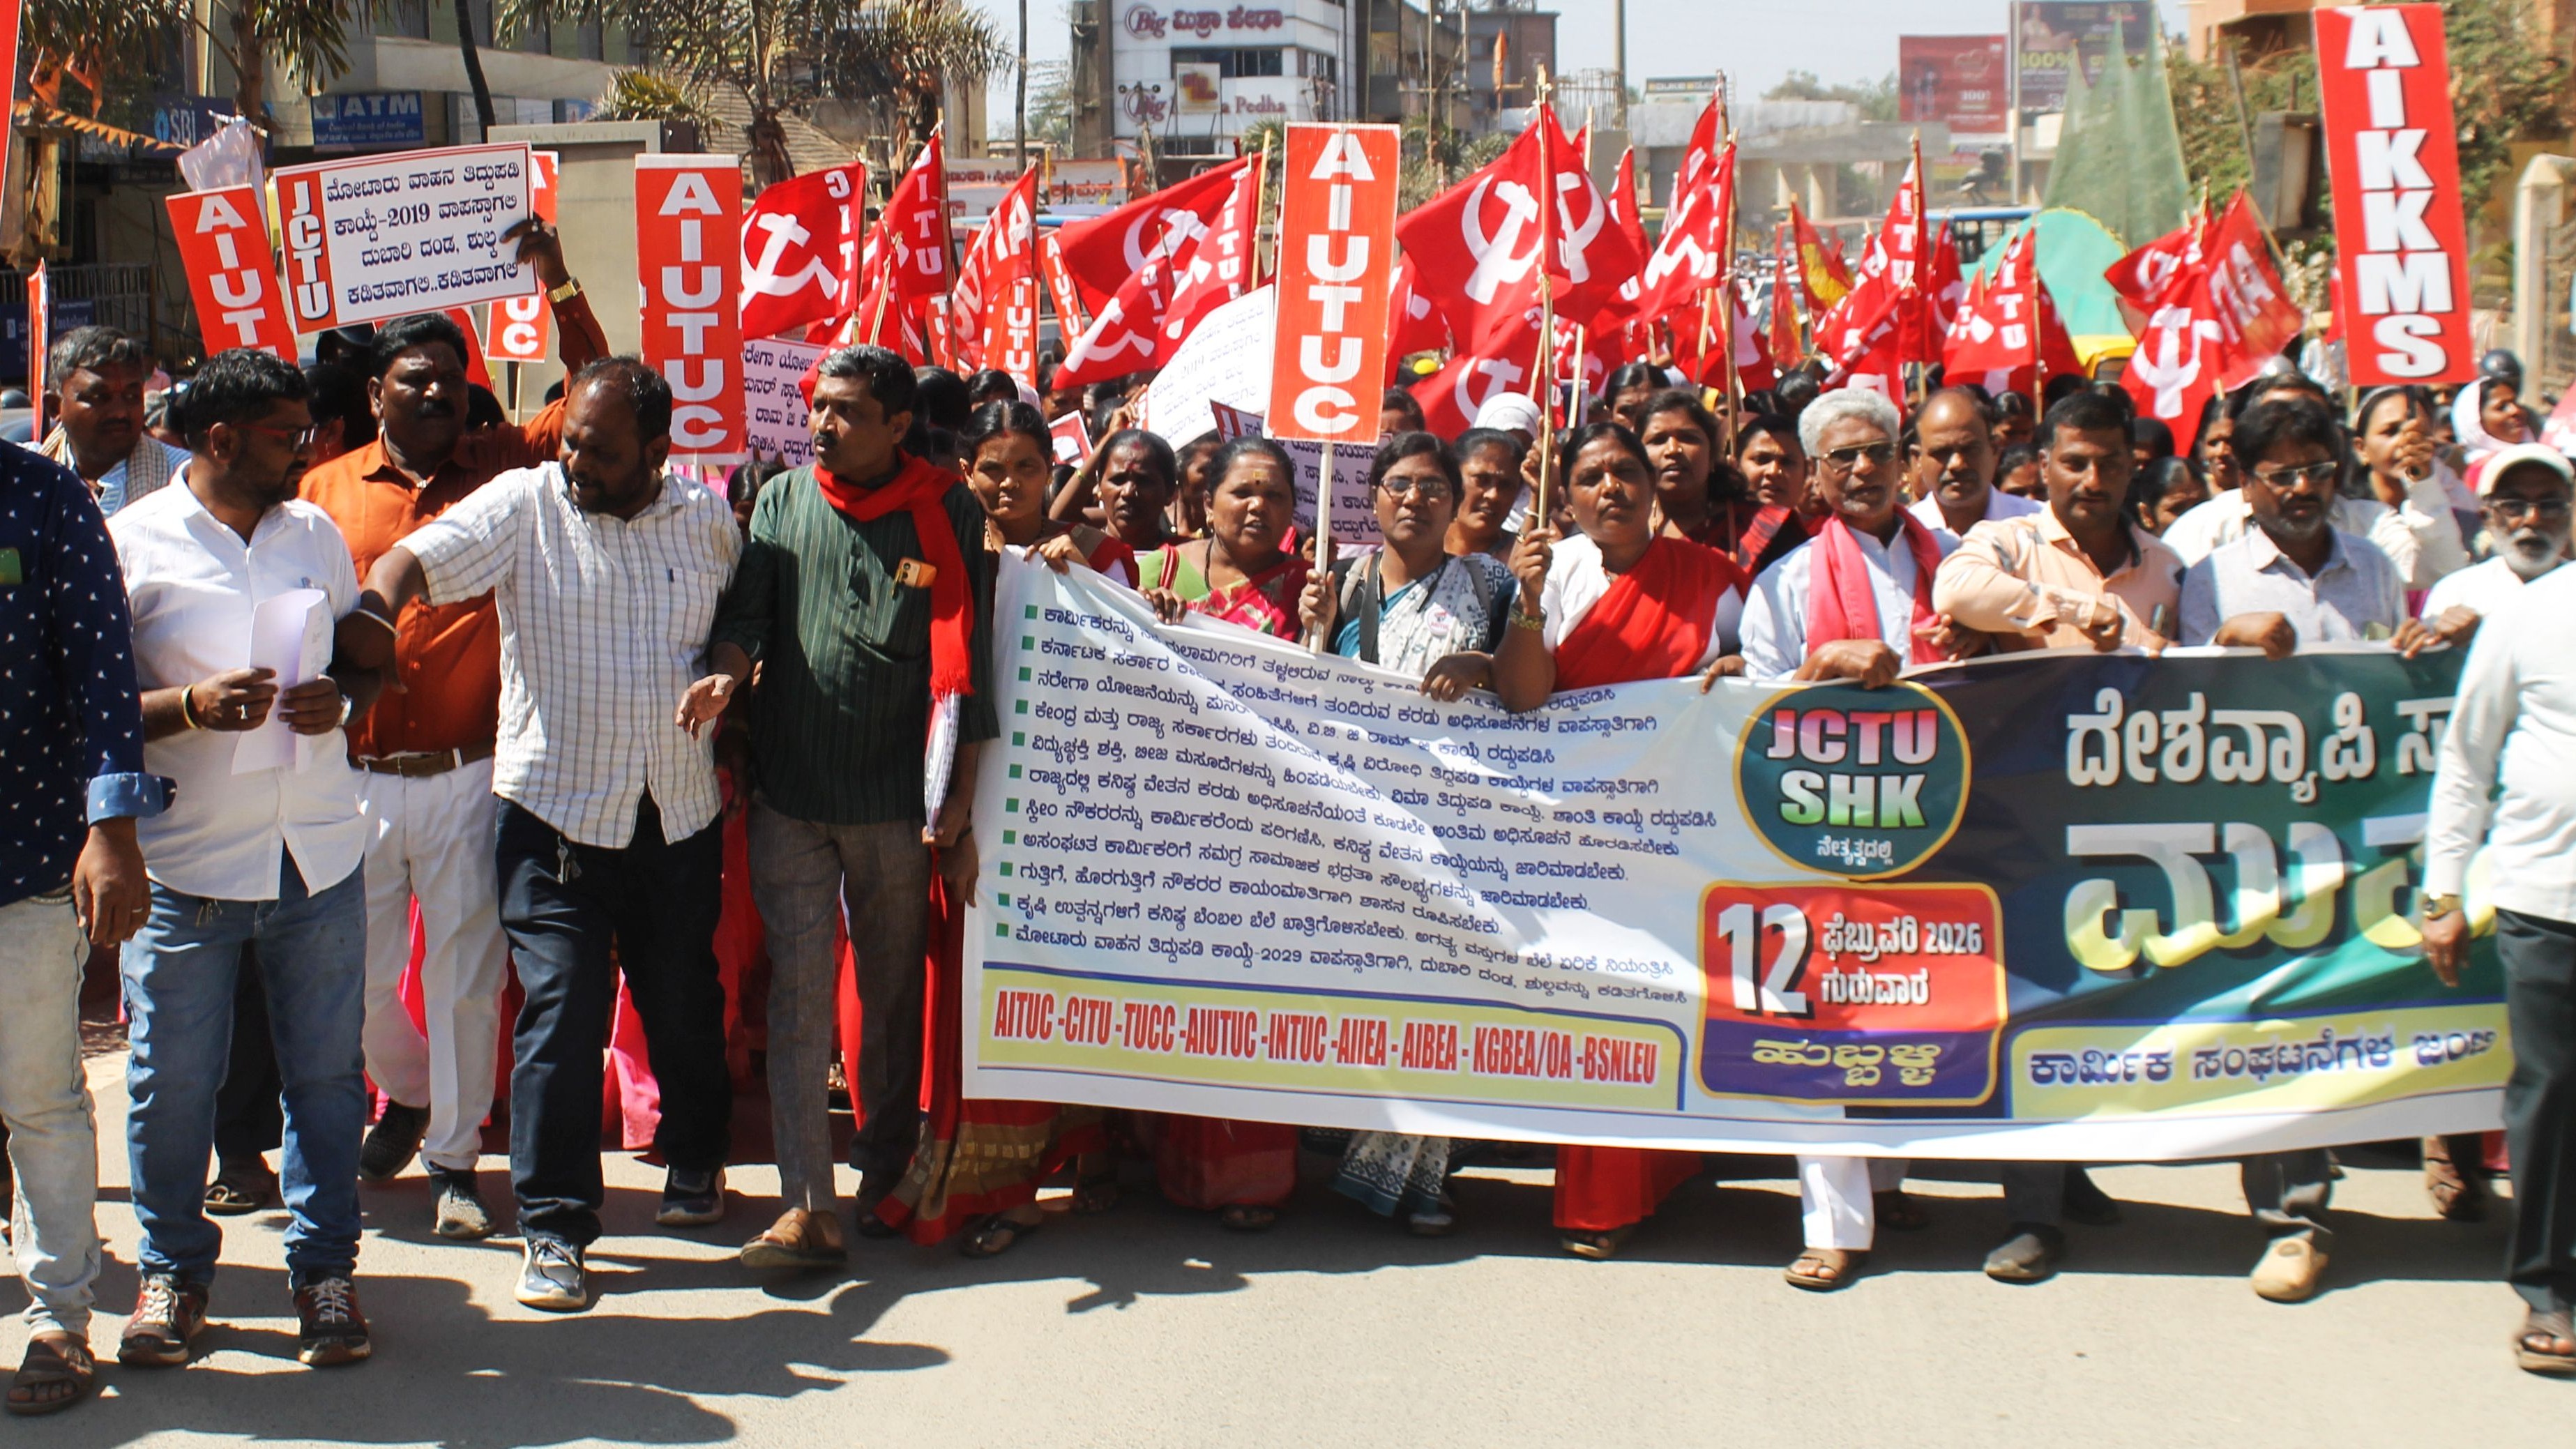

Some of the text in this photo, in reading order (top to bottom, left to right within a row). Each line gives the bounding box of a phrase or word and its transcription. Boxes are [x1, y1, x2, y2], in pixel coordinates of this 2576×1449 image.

[1135, 10, 1168, 38] Big
[344, 95, 419, 117] ATM
[1235, 94, 1286, 114] Pedha
[327, 161, 520, 203] ಮೋಟಾರು ವಾಹನ ತಿದ್ದುಪಡಿ
[439, 193, 518, 225] ವಾಪಸ್ಸಾಗಲಿ
[2344, 8, 2454, 377] AIKKMS
[288, 180, 330, 319] JCTU
[362, 243, 411, 268] ದುಬಾರಿ
[467, 231, 498, 259] ಶುಲ್ಕ
[658, 172, 728, 448] AIUTUC
[1294, 133, 1375, 434] AIUTUC
[1044, 608, 1134, 642] ಕಾರ್ಮಿಕರನ್ನು
[1040, 637, 1106, 660] ಕರ್ನಾಟಕ
[1112, 650, 1169, 672] ಸರ್ಕಾರ
[1325, 697, 1391, 719] ತಂದಿರುವ
[1398, 705, 1440, 725] ಕರಡು
[1448, 713, 1550, 732] ಅಧಿಸೂಚನೆಗಳ
[1558, 715, 1658, 738] ವಾಪಸ್ಸಾತಿಗಾಗಿ
[1038, 669, 1089, 692] ನರೇಗಾ
[1096, 674, 1199, 715] ಯೋಜನೆಯನ್ನು
[1439, 739, 1480, 766] ಕಾಯ್ದೆ
[1487, 744, 1555, 770] ರದ್ದುಪಡಿಸಿ
[1767, 708, 1939, 765] JCTU
[2066, 687, 2375, 803] ದೇಶವ್ಯಾಪಿ
[1035, 701, 1077, 727] ಕೇಂದ್ರ
[1084, 706, 1119, 731] ಮತ್ತು
[1127, 712, 1165, 740] ರಾಜ್ಯ
[1172, 719, 1258, 747] ಸರ್ಕಾರಗಳು
[1327, 751, 1356, 774] ಕೃಷಿ
[1363, 755, 1423, 777] ವಿರೋಧಿ
[1487, 773, 1554, 798] ಕಾಯ್ದೆಗಳ
[1561, 777, 1659, 801] ವಾಪಸ್ಸಾತಿಗಾಗಿ
[1029, 768, 1090, 796] ರಾಜ್ಯದಲ್ಲಿ
[1098, 771, 1136, 799] ಕನಿಷ್ಠ
[1144, 775, 1190, 794] ವೇತನ
[1198, 781, 1240, 801] ಕರಡು
[1248, 791, 1367, 824] ಅಧಿಸೂಚನೆಯಂತೆ
[1374, 812, 1425, 835] ಕೂಡಲೇ
[1432, 823, 1487, 841] ಅಂತಿಮ
[1494, 828, 1571, 847] ಅಧಿಸೂಚನೆ
[1097, 740, 1127, 763] ಶಕ್ತಿ,
[1135, 745, 1168, 761] ಬೀಜ
[1176, 747, 1276, 789] ಮಸೂದೆಗಳನ್ನು
[1391, 787, 1429, 806] ವಿಮಾ
[1437, 791, 1492, 817] ತಿದ್ದುಪಡಿ
[1553, 809, 1596, 825] ಶಾಂತಿ
[1603, 808, 1644, 833] ಕಾಯ್ದೆ
[1651, 809, 1717, 835] ರದ್ದುಪಡಿಸಿ
[1780, 769, 1928, 828] SHK
[1023, 831, 1098, 853] ಅಸಂಘಟಿತ
[1105, 839, 1191, 858] ಕಾರ್ಮಿಕರಿಗೆ
[1199, 843, 1242, 867] ಸಮಗ್ರ
[1249, 850, 1320, 873] ಸಾಮಾಜಿಕ
[1328, 862, 1373, 882] ಭದ್ರತಾ
[1381, 872, 1475, 908] ಸೌಲಭ್ಯಗಳನ್ನು
[1026, 798, 1058, 824] ಸ್ಕೀಂ
[1066, 801, 1144, 831] ನೌಕರರನ್ನು
[1151, 810, 1253, 833] ಕಾರ್ಮಿಕರೆಂದು
[1379, 841, 1423, 863] ವೇತನ
[1430, 853, 1508, 882] ಕಾಯ್ದೆಯನ್ನು
[1817, 835, 1893, 866] ನೇತೃತ್ವದಲ್ಲಿ
[1020, 861, 1068, 886] ಗುತ್ತಿಗೆ,
[1075, 866, 1155, 893] ಹೊರಗುತ್ತಿಗೆ
[1162, 872, 1222, 892] ನೌಕರರ
[1360, 895, 1405, 913] ಶಾಸನ
[1016, 924, 1087, 948] ಮೋಟಾರು
[1094, 934, 1141, 952] ವಾಹನ
[1149, 936, 1204, 963] ತಿದ್ದುಪಡಿ
[1420, 956, 1471, 976] ದುಬಾರಿ
[1017, 894, 1047, 920] ಕೃಷಿ
[1055, 899, 1140, 925] ಉತ್ಪನ್ನಗಳಿಗೆ
[1148, 904, 1187, 932] ಕನಿಷ್ಠ
[1194, 906, 1242, 926] ಬೆಂಬಲ
[1250, 911, 1275, 928] ಬೆಲೆ
[1416, 930, 1457, 958] ಅಗತ್ಯ
[1465, 942, 1519, 964] ವಸ್ತುಗಳ
[1527, 953, 1552, 969] ಬೆಲೆ
[1718, 902, 1809, 1015] 12
[1925, 921, 1984, 955] 2026
[1821, 969, 1930, 1006] ಗುರುವಾರ
[2030, 1046, 2172, 1085] ಕಾರ್ಮಿಕ
[2195, 1028, 2395, 1082] ಸಂಘಟನೆಗಳ
